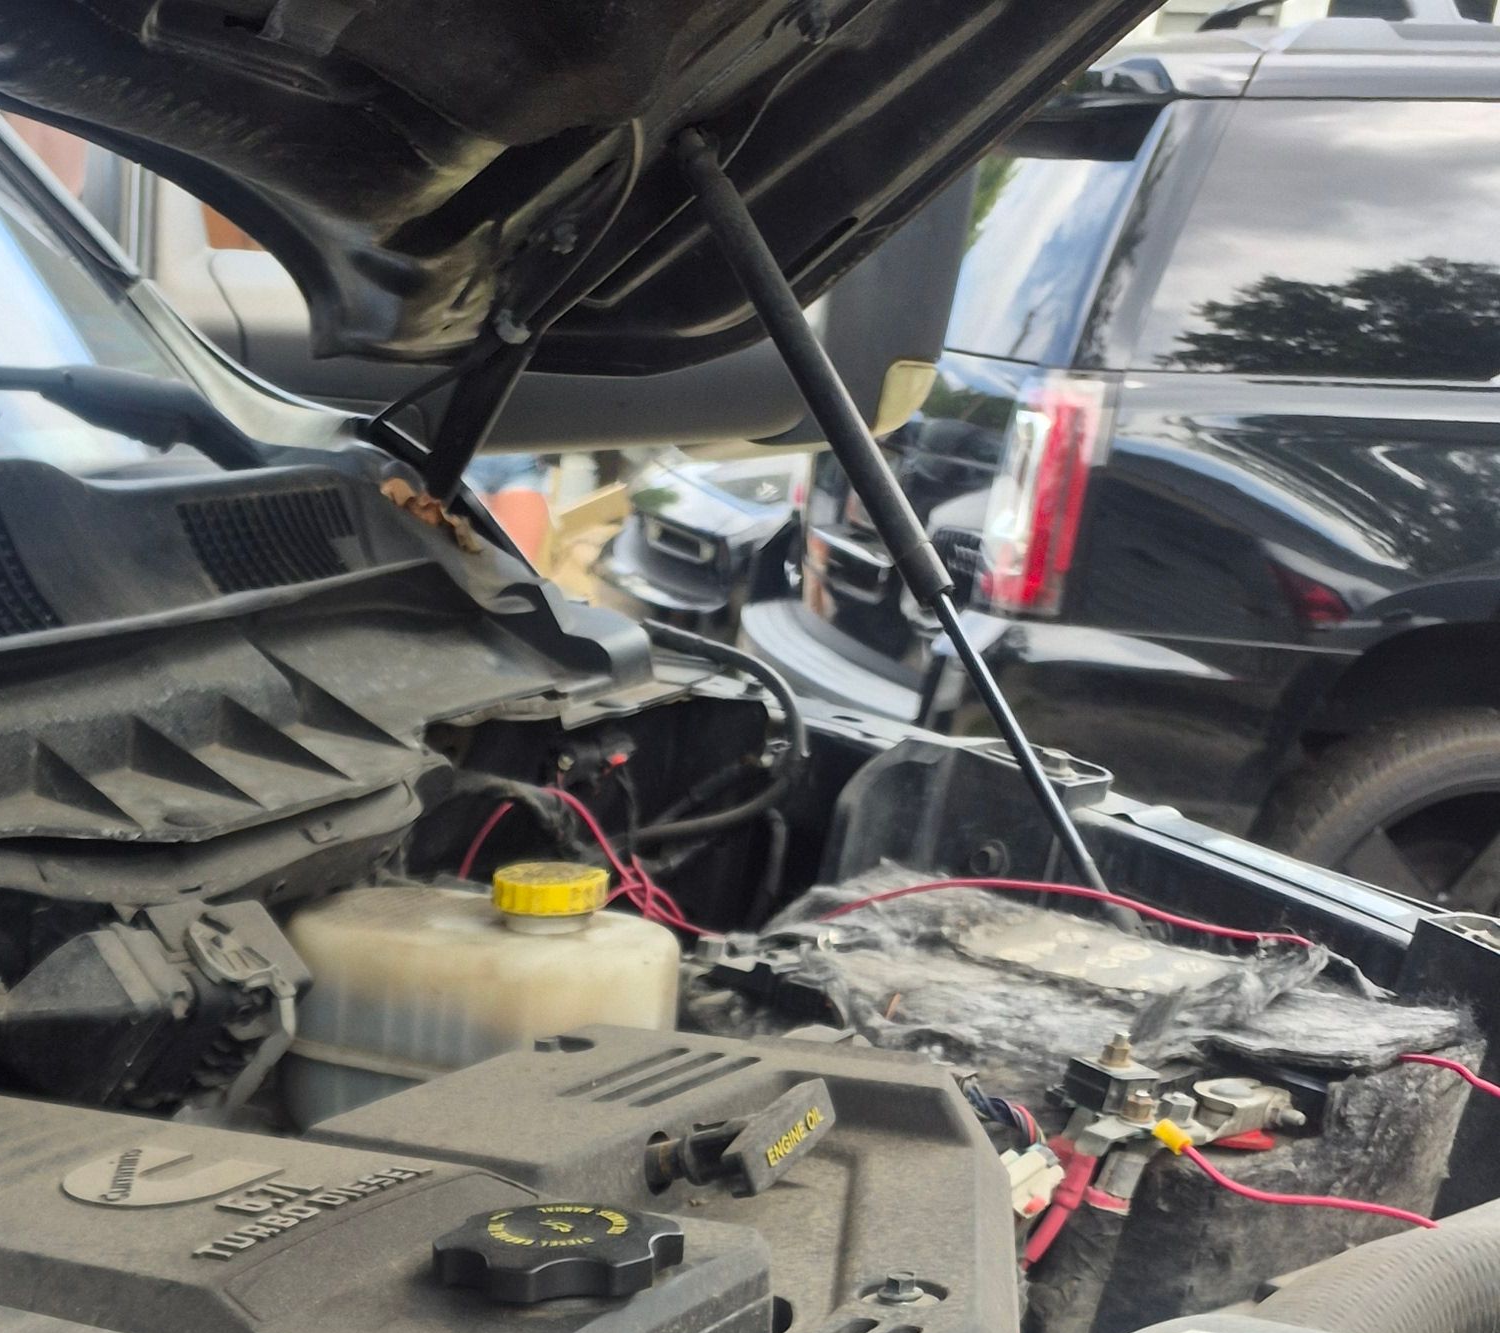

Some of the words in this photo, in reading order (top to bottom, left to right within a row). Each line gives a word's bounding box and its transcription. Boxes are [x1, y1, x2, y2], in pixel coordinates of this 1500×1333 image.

[765, 1121, 809, 1168] ENGINE
[805, 1106, 825, 1132] OIL
[99, 1148, 143, 1201] Cummins
[215, 1180, 324, 1217] 6.7L
[191, 1203, 322, 1261] TURBO
[306, 1166, 433, 1210] DIESEL
